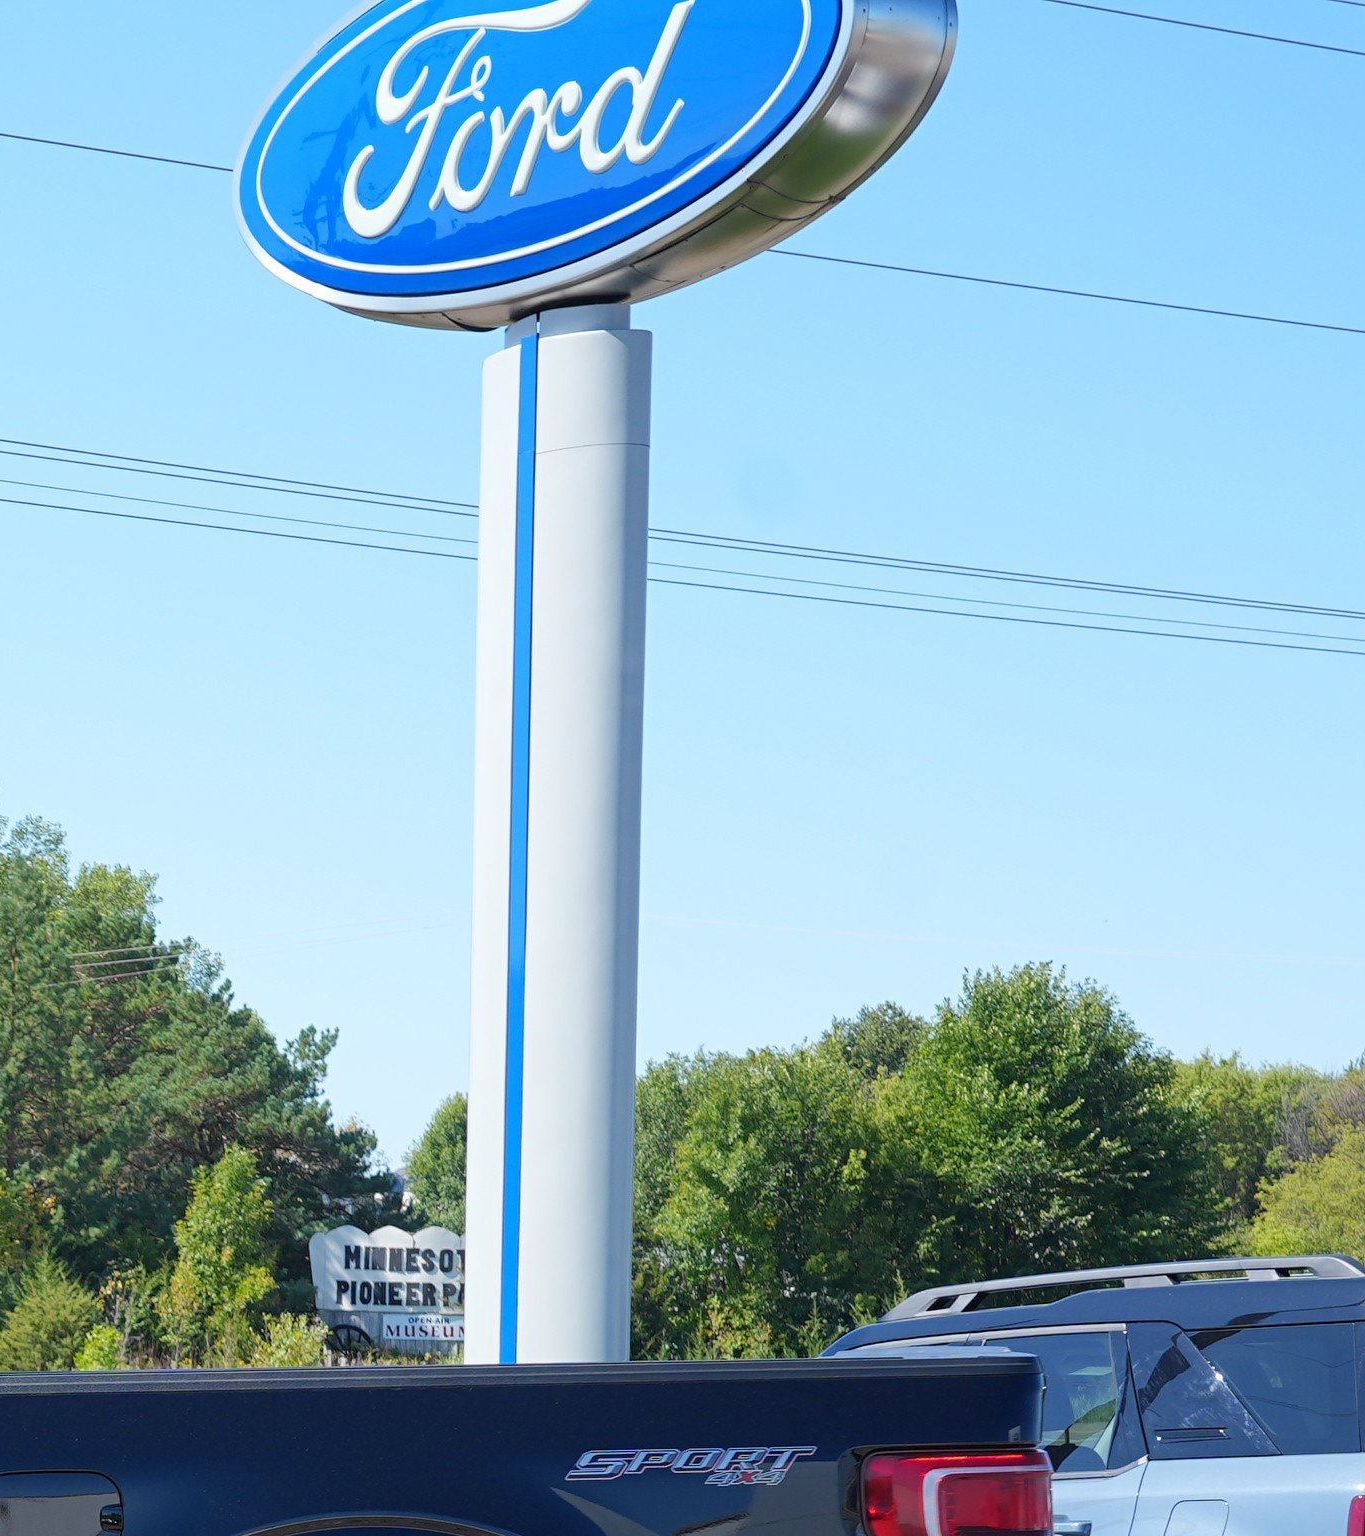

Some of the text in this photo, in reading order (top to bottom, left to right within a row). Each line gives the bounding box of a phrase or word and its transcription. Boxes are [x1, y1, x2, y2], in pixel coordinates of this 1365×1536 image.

[343, 0, 696, 239] Ford
[336, 1280, 437, 1307] PIONEER
[564, 1445, 818, 1481] SPORT
